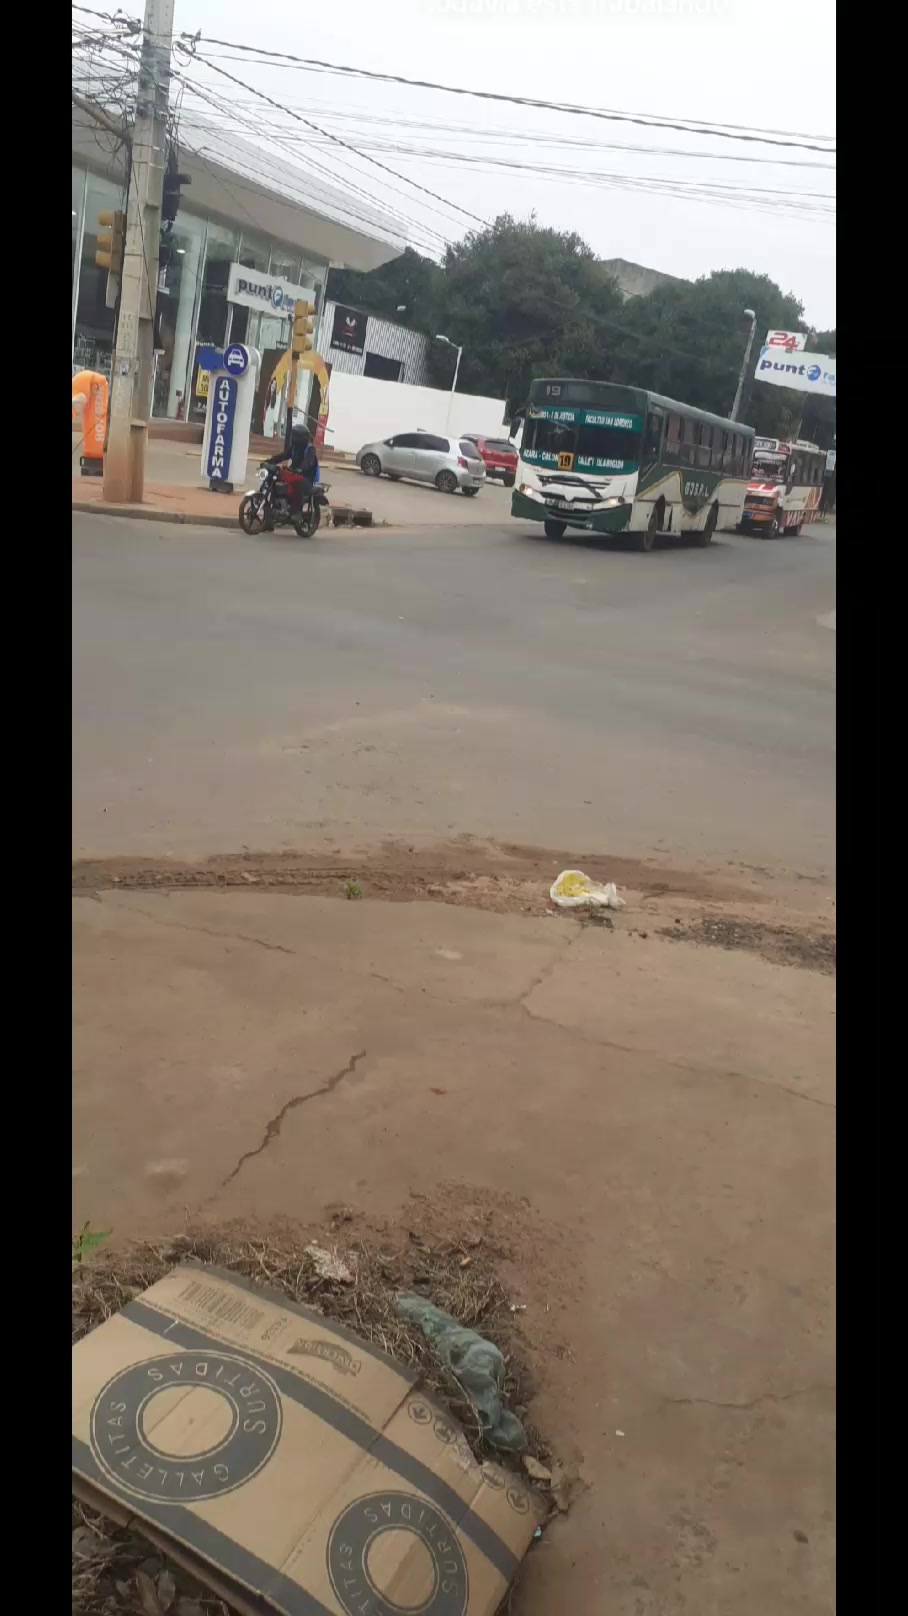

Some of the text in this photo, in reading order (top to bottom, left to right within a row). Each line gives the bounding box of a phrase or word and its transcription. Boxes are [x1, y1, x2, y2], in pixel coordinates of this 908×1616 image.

[769, 332, 799, 350] 24
[546, 385, 561, 396] 19
[211, 379, 231, 478] AUTOFARMA
[559, 454, 572, 467] 19
[147, 1361, 267, 1435] SURTIDAS
[107, 1401, 229, 1488] GALLETITAS
[363, 1500, 458, 1596] SURTIDAS
